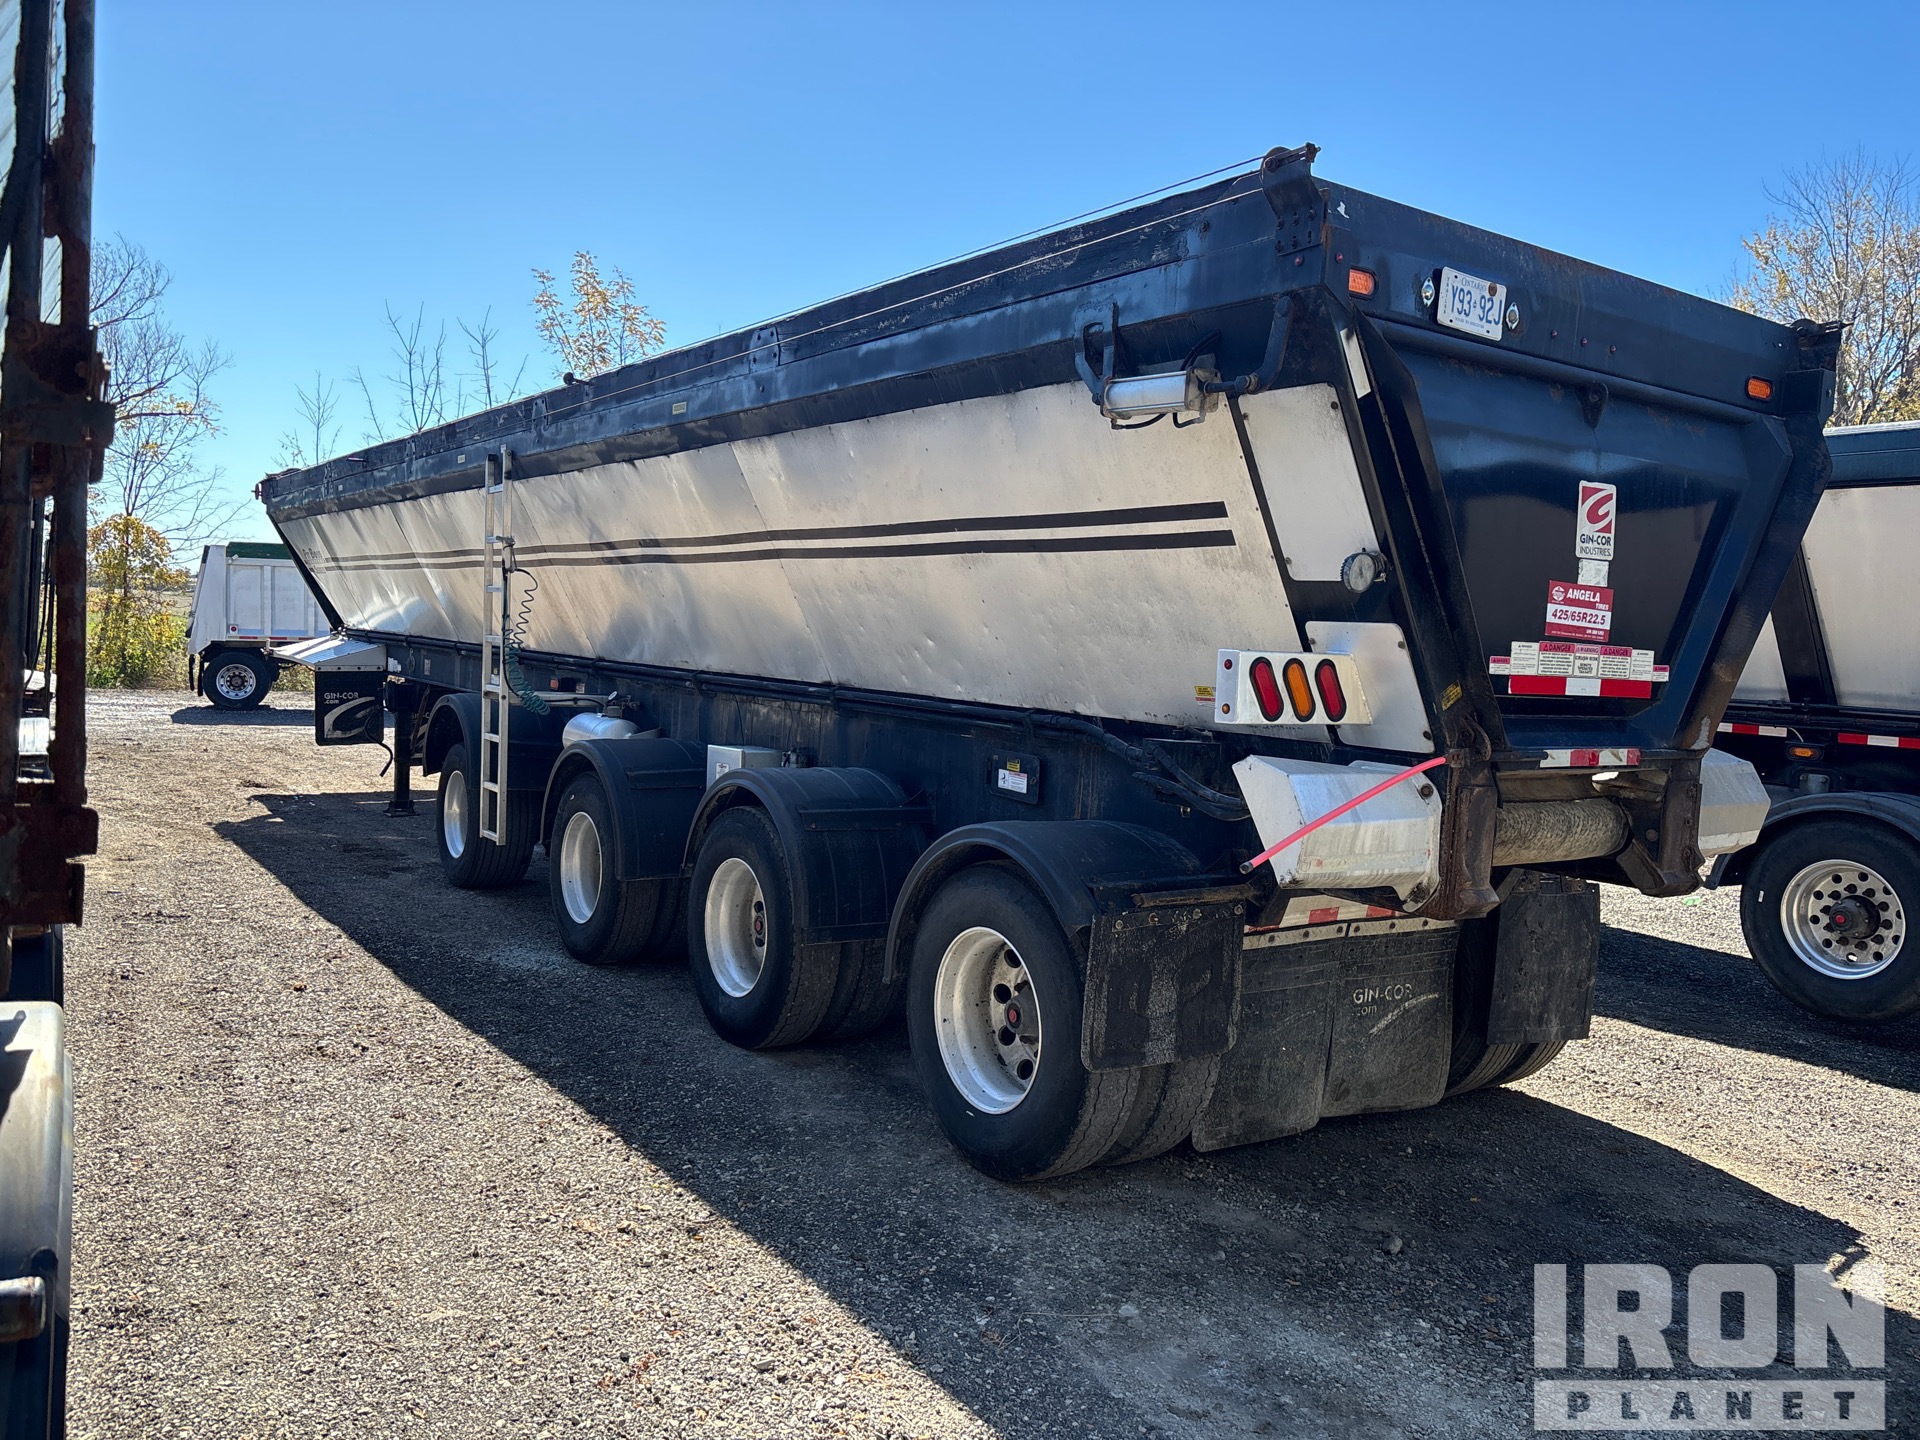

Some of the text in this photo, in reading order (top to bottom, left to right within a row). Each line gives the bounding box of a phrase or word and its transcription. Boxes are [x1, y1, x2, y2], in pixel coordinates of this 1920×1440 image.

[1451, 284, 1503, 326] Y93 92J
[1579, 533, 1612, 547] GIN-COR
[1566, 588, 1601, 603] ANGELA
[1551, 608, 1606, 626] 425/65R22.5
[1548, 643, 1572, 652] DANGER
[1608, 648, 1629, 657] DANGER
[323, 692, 359, 700] GIN-COR
